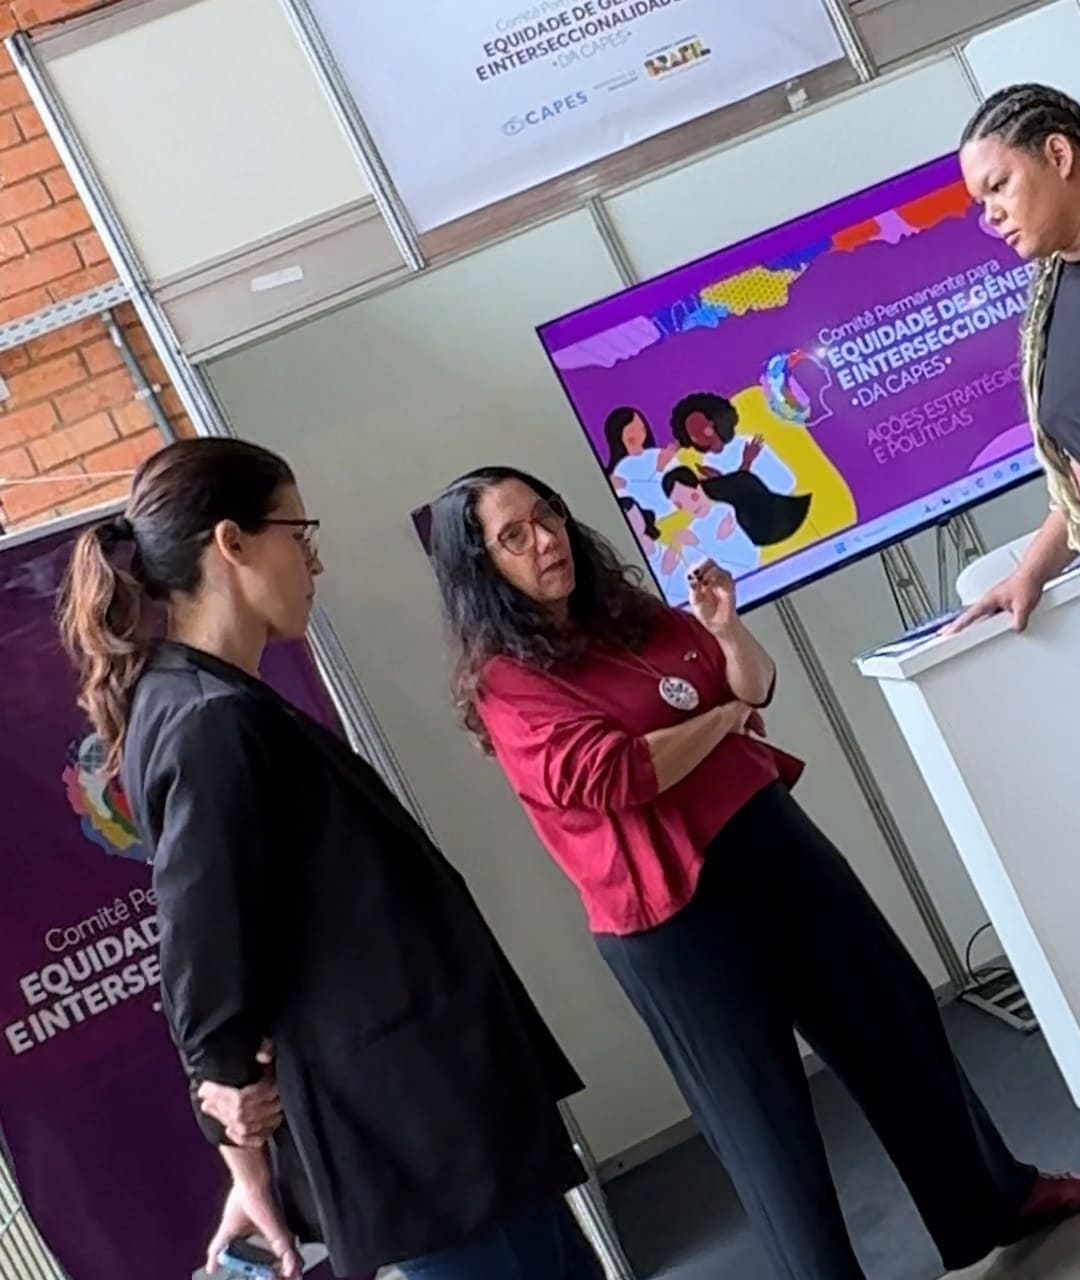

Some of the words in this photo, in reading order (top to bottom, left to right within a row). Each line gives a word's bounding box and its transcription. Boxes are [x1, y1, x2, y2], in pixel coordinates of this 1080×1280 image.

[483, 9, 572, 58] EQUIDADE
[571, 0, 597, 21] DE
[476, 65, 494, 81] E
[525, 90, 588, 126] CAPES
[818, 309, 876, 346] Comitê
[875, 274, 967, 321] Permanente
[968, 258, 1000, 288] para
[827, 308, 938, 369] EQUIDADE
[937, 293, 972, 320] DE
[970, 261, 1037, 308] GÊNER
[850, 293, 1029, 385] INTERSECCIONAL
[857, 383, 889, 408] DA
[888, 357, 947, 395] CAPES
[873, 447, 890, 464] E
[45, 898, 130, 953] Comitê
[19, 915, 161, 1006] EQUIDAD
[5, 1022, 34, 1056] E
[29, 954, 161, 1044] INTERSE
